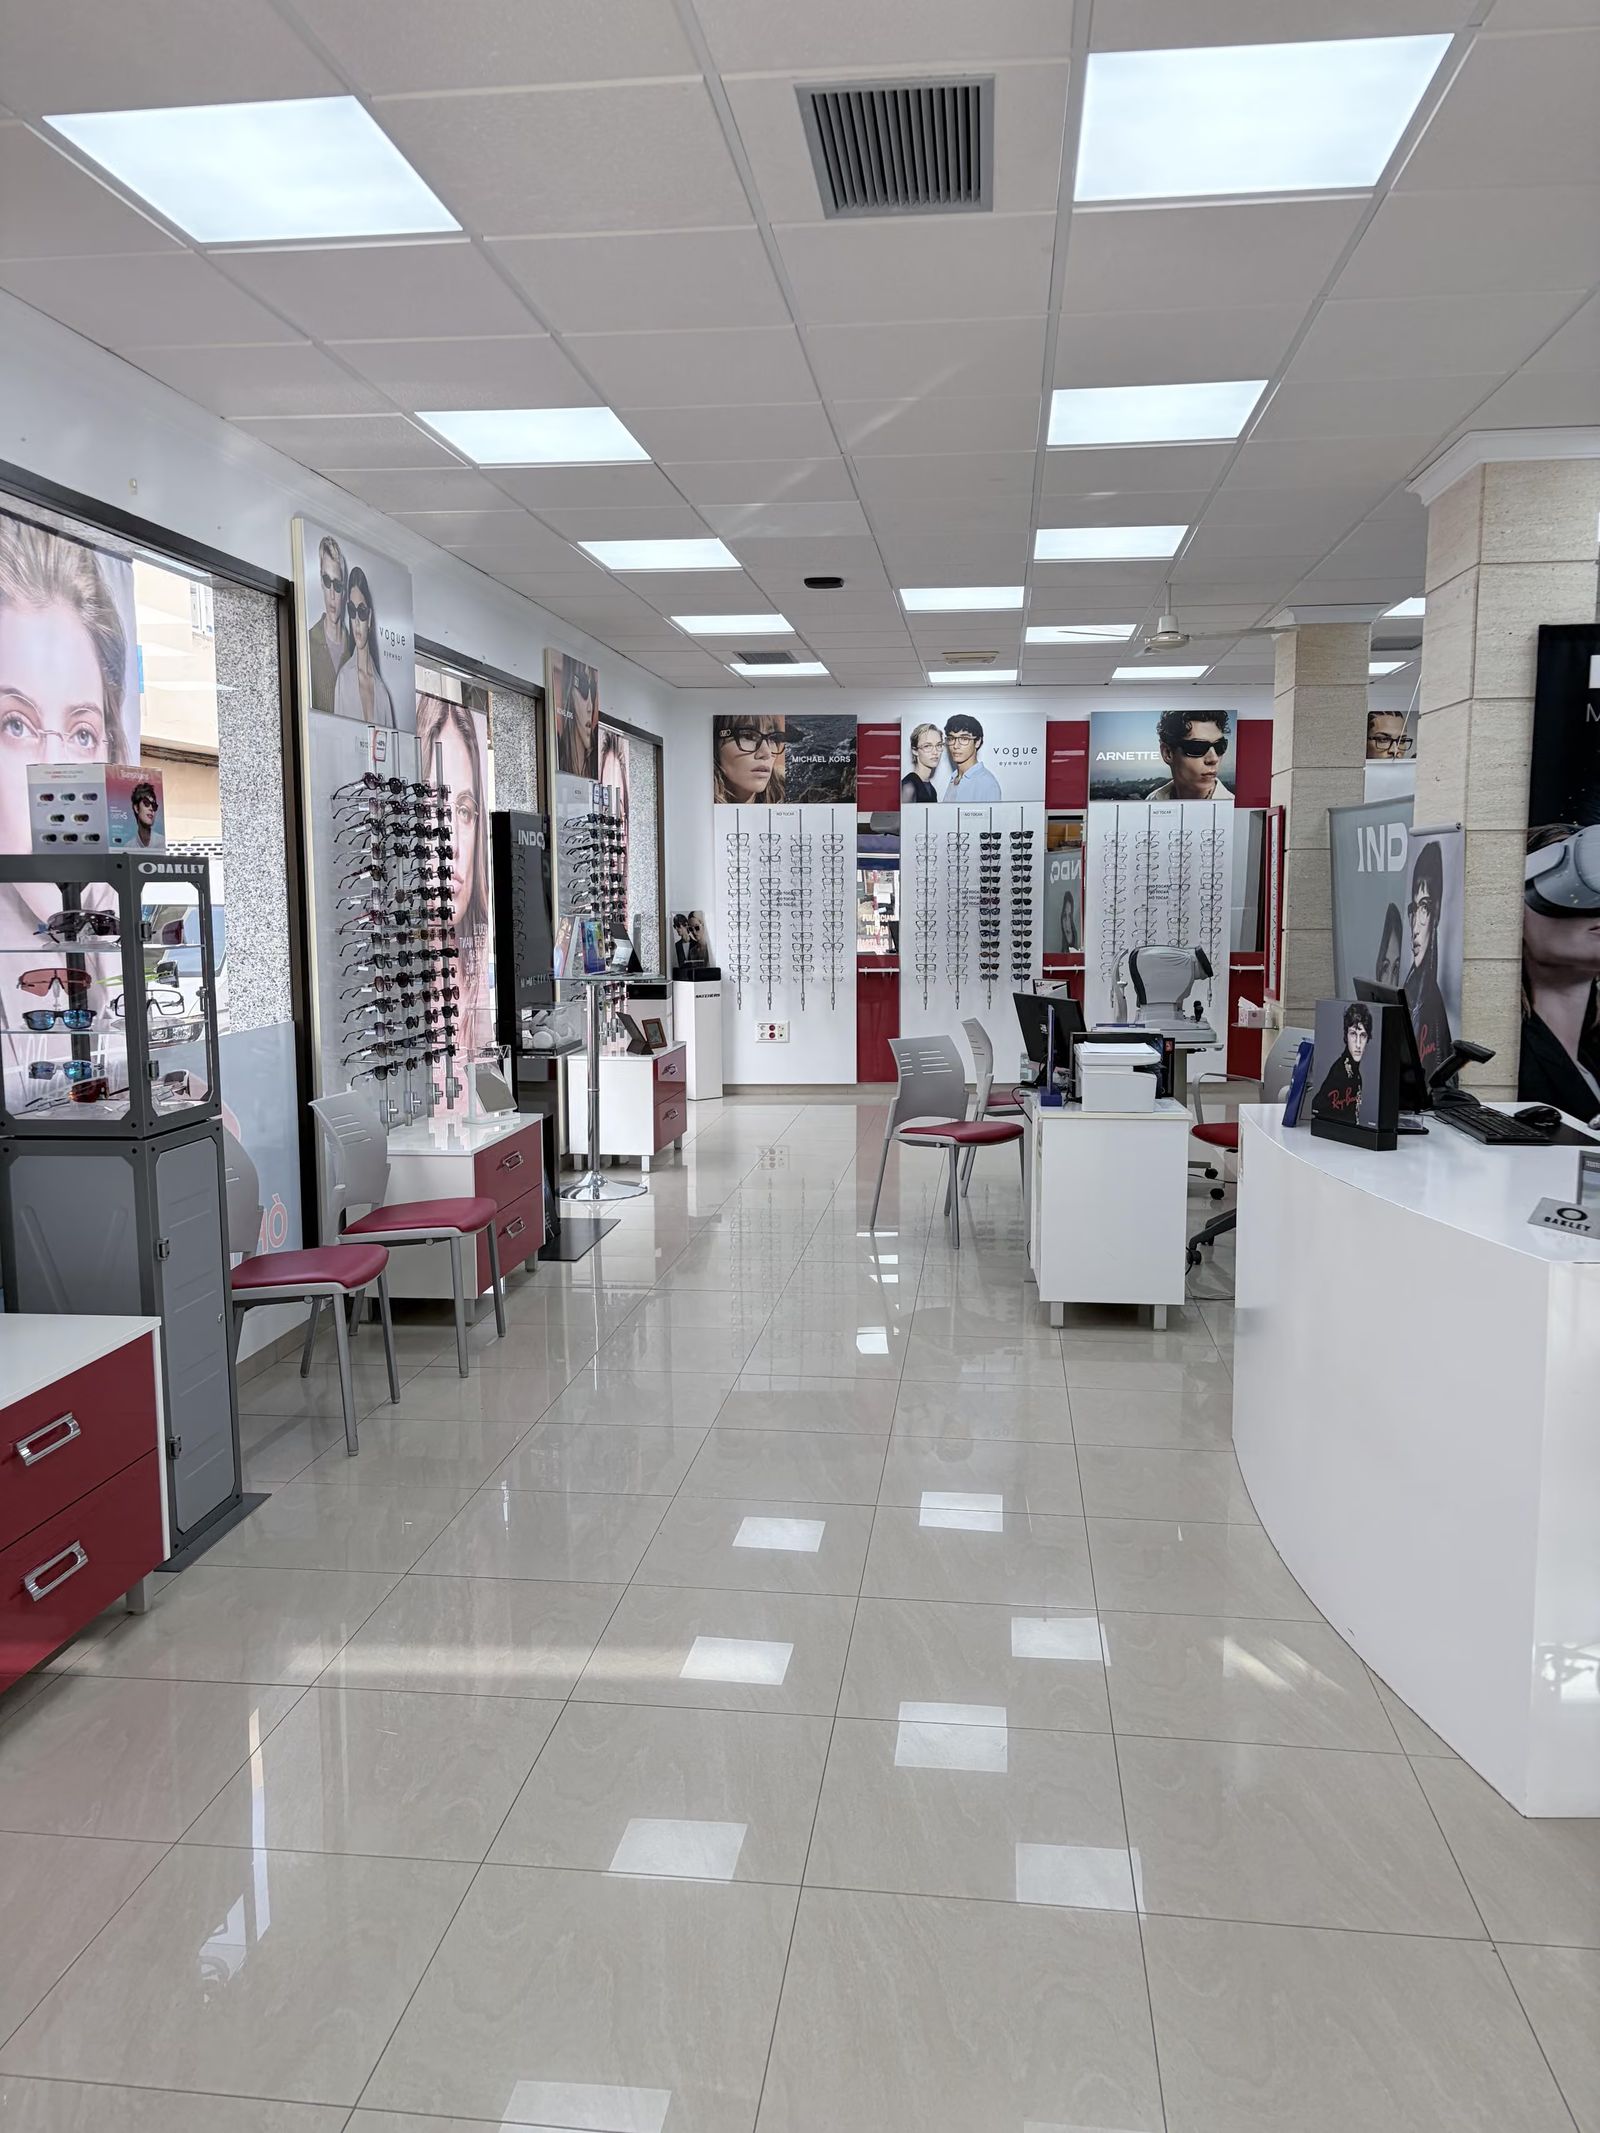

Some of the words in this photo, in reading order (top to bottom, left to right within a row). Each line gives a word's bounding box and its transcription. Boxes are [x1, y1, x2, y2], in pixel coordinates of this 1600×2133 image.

[379, 626, 406, 647] vogue
[791, 755, 827, 763] MICHAEL
[829, 755, 851, 763] KORS
[993, 746, 1038, 758] vogue
[1096, 751, 1160, 761] ARNETTE
[1357, 822, 1409, 873] IND
[157, 862, 205, 875] OAKLEY
[1327, 1088, 1362, 1110] Ray-Ban
[1544, 1216, 1591, 1232] OAKLEY
